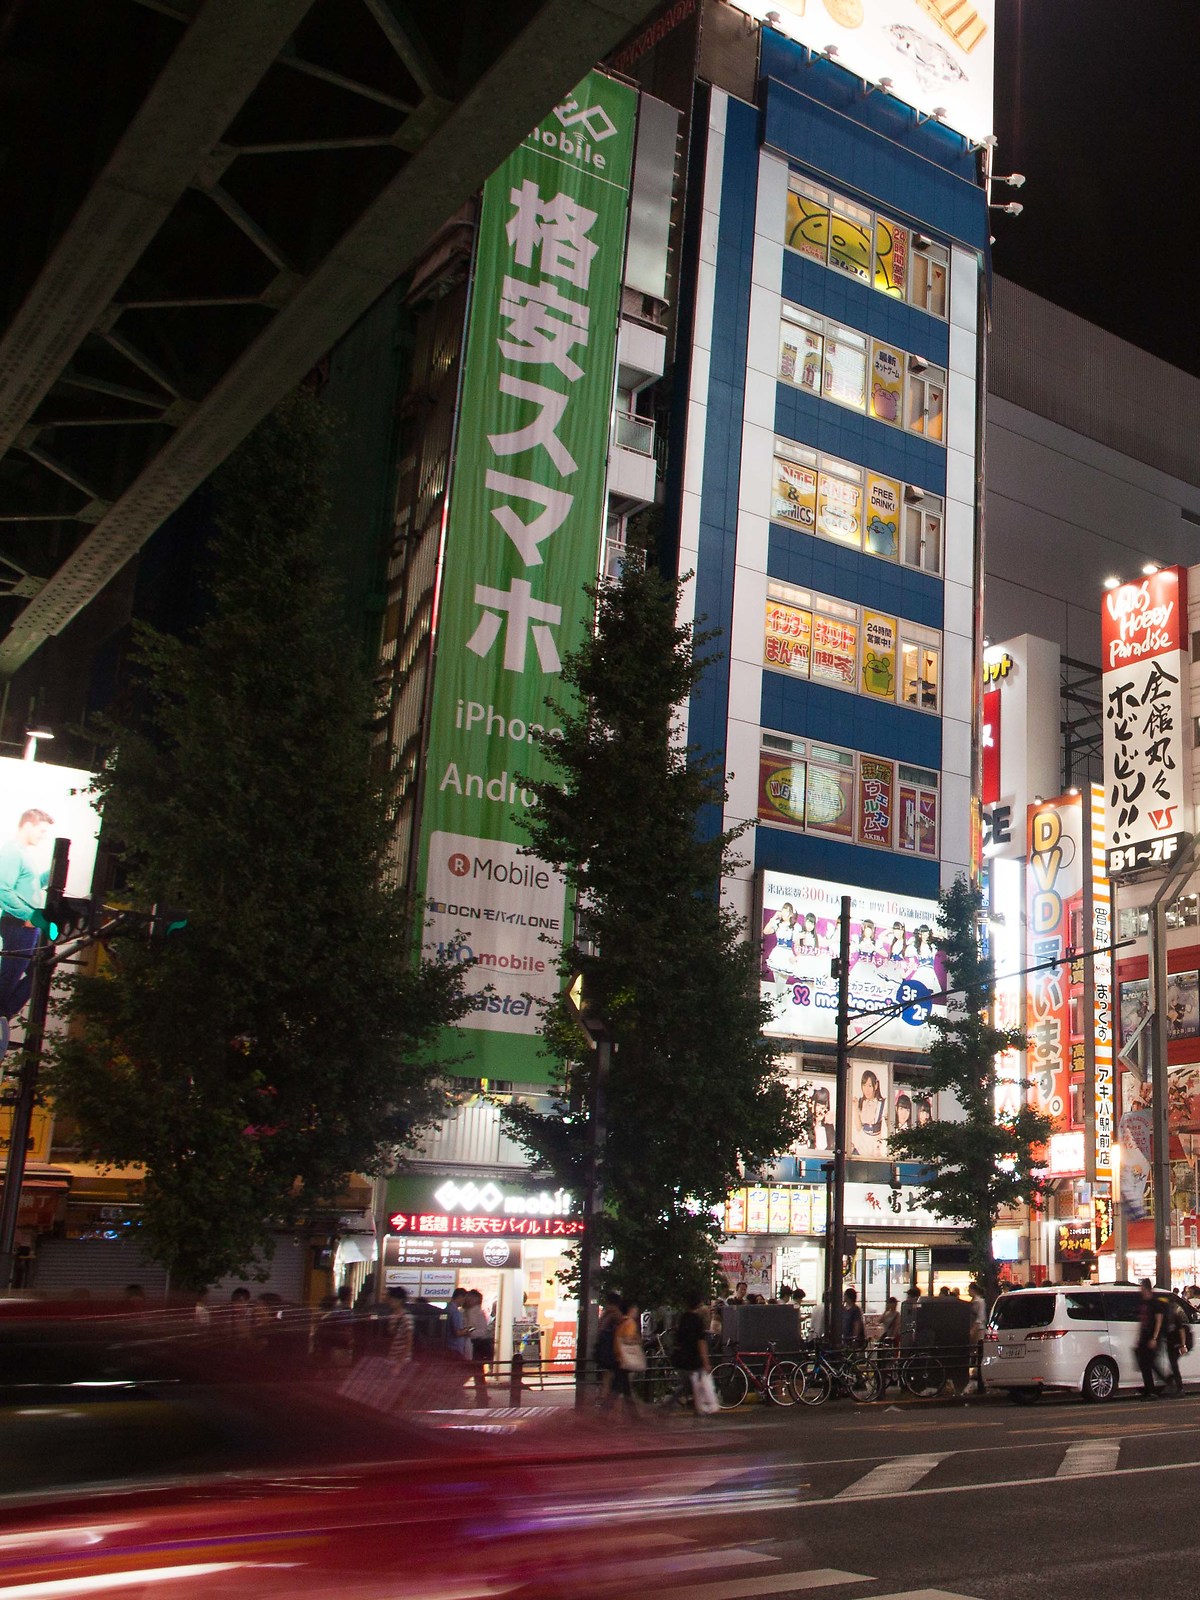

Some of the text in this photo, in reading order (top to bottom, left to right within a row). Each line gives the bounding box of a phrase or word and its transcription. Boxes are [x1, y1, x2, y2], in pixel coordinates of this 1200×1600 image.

[879, 351, 898, 365] 最新
[466, 178, 600, 674] 格安スマホ
[787, 486, 799, 502] &
[872, 486, 894, 501] FREE
[871, 497, 895, 512] DRINK!
[867, 622, 892, 638] 24時間
[440, 763, 541, 808] Andro
[864, 834, 885, 843] AKIBA
[474, 857, 549, 889] Mobile
[448, 904, 482, 919] OCN
[528, 914, 560, 930] ONE
[478, 953, 546, 974] mobile
[902, 985, 917, 1000] 3F
[912, 1004, 928, 1020] 2F
[1097, 1069, 1110, 1165] アキバ駅前店
[424, 1287, 451, 1296] brastel
